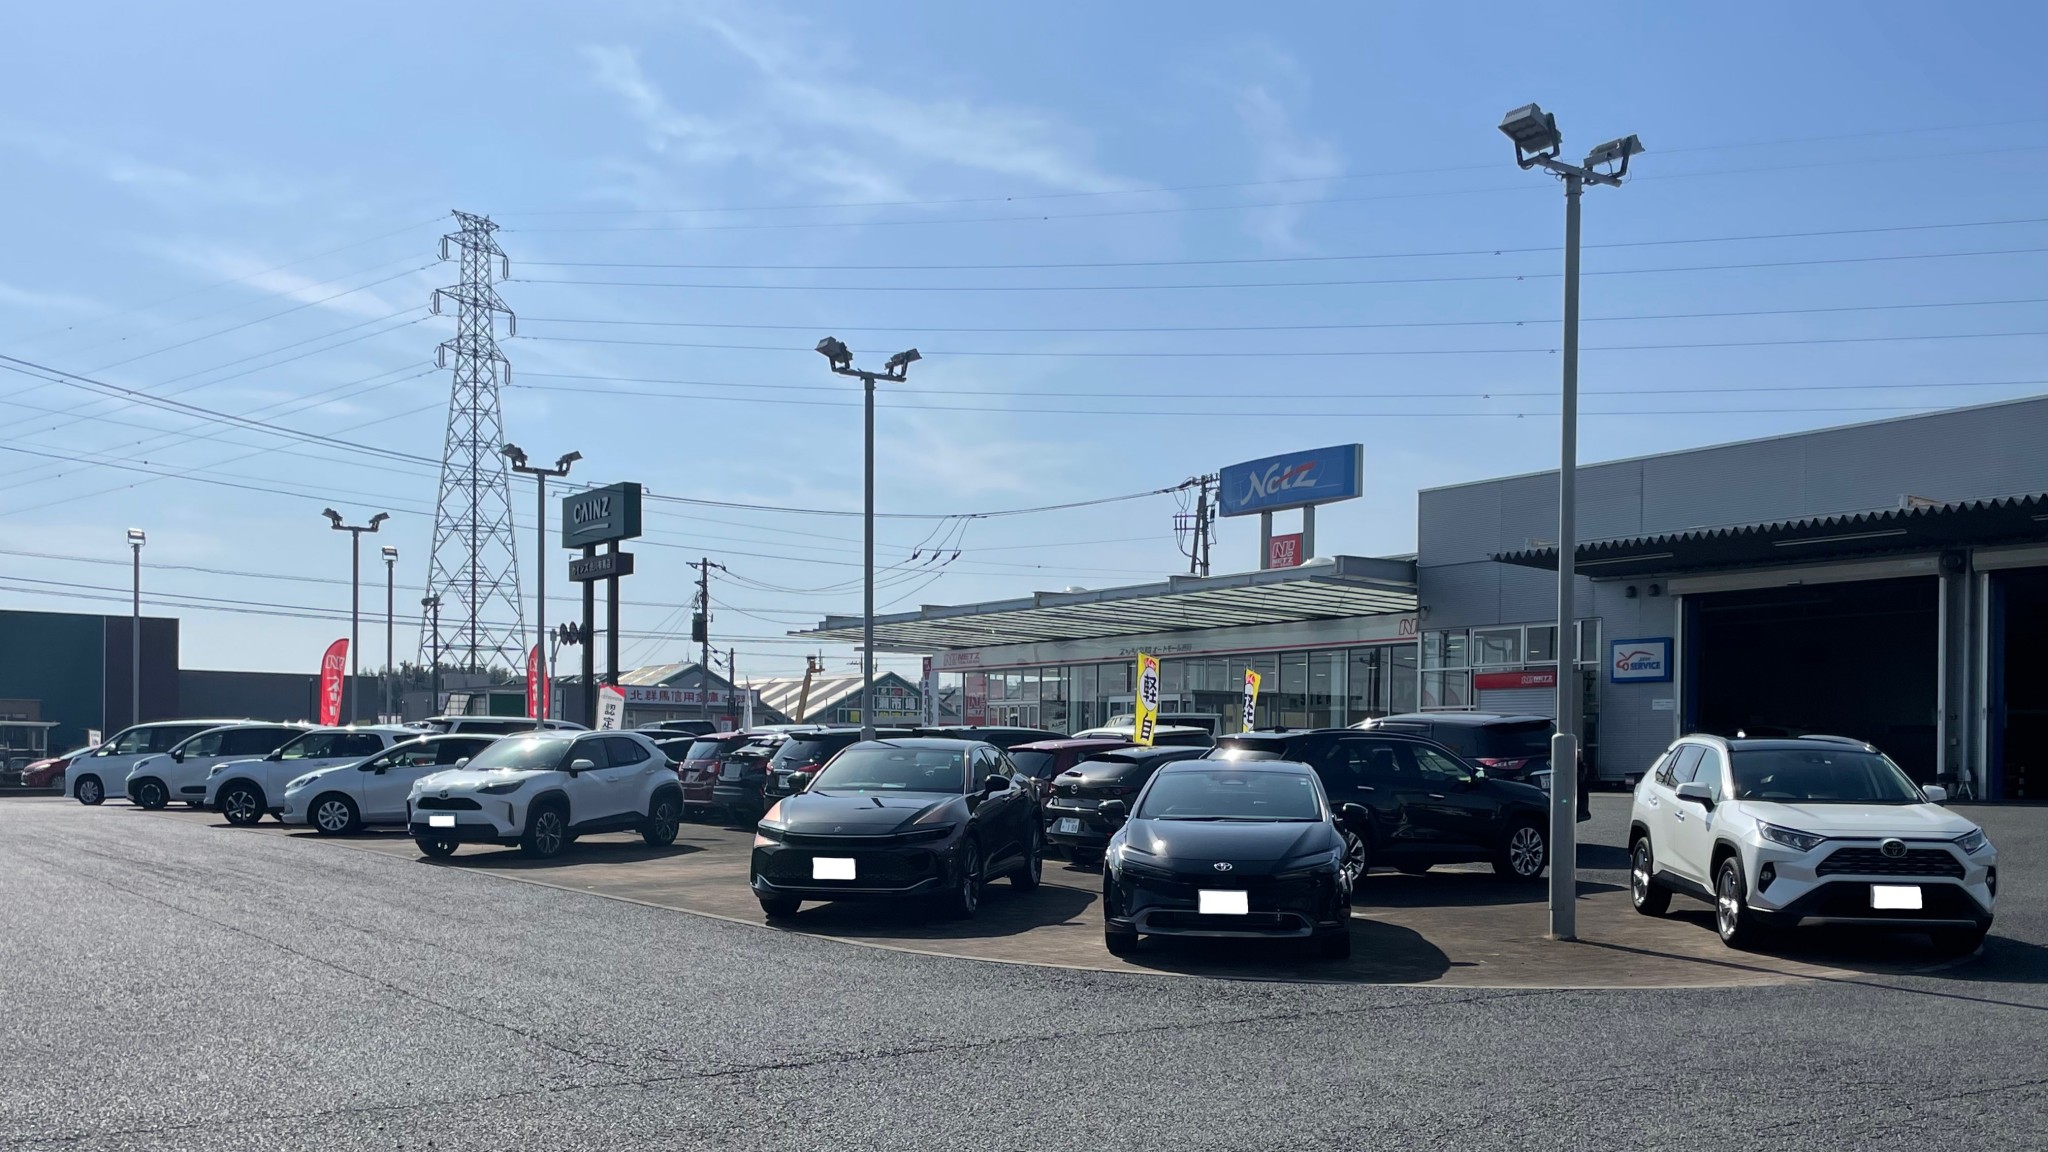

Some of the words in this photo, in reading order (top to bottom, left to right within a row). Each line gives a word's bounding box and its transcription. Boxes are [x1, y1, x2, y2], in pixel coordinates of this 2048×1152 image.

[1240, 460, 1317, 506] Netz
[573, 496, 609, 525] CAINZ
[1630, 661, 1661, 670] SERVICE
